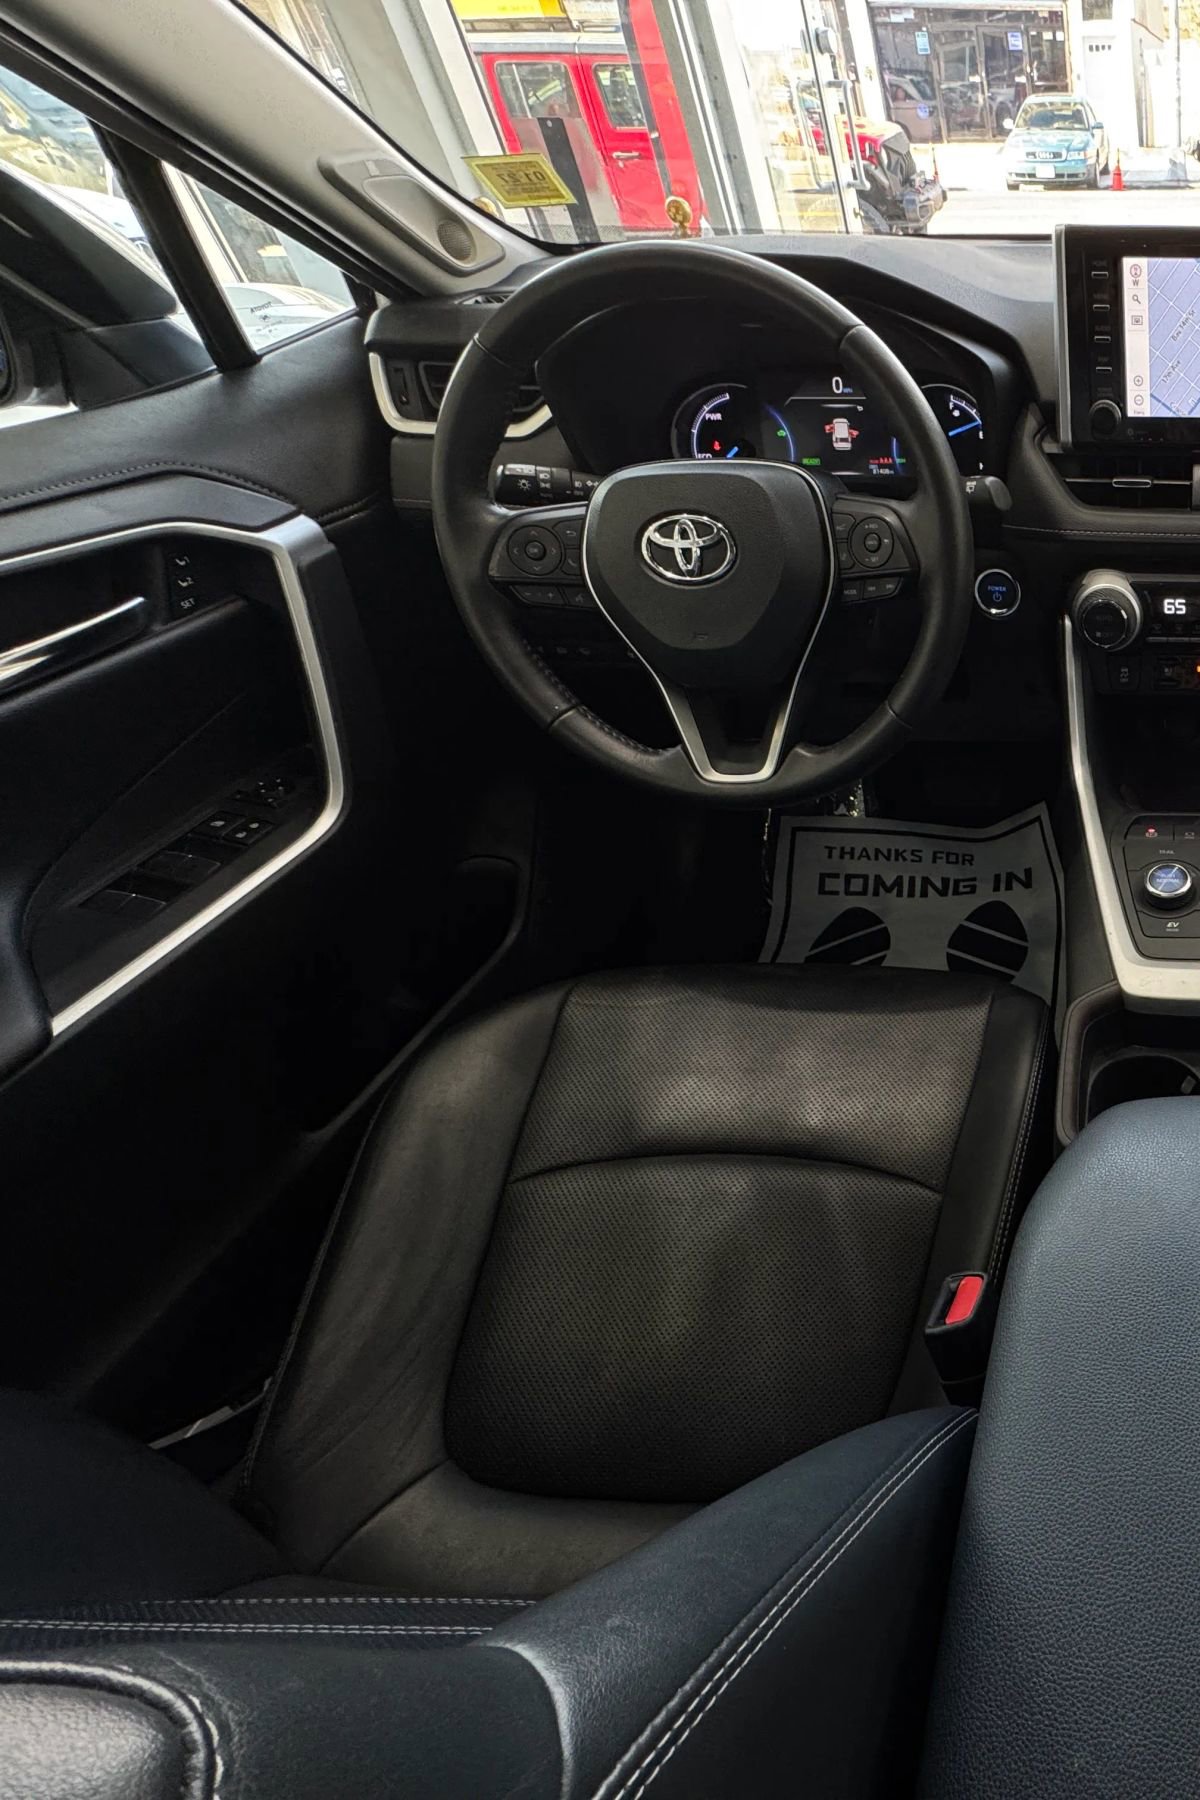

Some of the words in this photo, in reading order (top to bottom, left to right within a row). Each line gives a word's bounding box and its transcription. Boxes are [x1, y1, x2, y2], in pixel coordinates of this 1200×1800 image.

[832, 376, 842, 394] 0
[705, 413, 722, 421] PWR
[180, 597, 195, 608] SET
[1163, 599, 1186, 615] 65
[824, 845, 923, 863] THANKS
[931, 850, 975, 866] FOR
[818, 872, 977, 898] COMING
[992, 867, 1033, 892] IN
